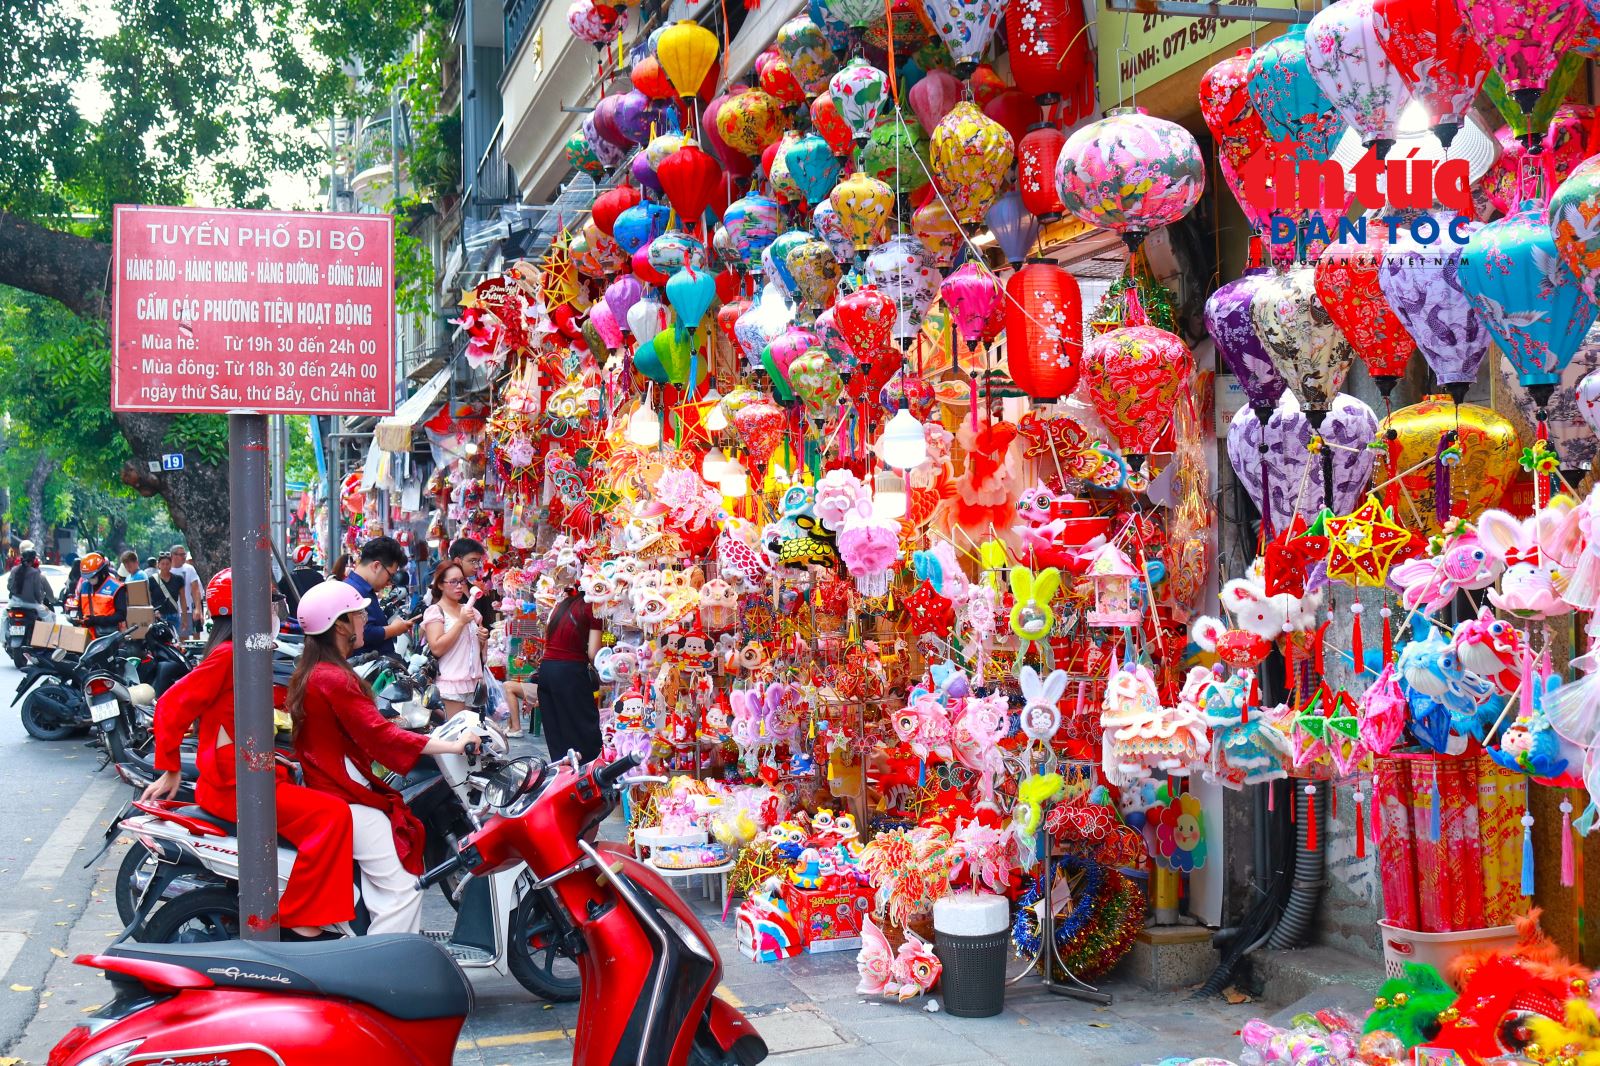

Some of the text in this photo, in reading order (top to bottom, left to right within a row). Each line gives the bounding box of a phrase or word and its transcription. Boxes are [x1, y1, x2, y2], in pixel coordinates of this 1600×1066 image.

[146, 219, 365, 257] TUYẾN PHỐ ĐI BỘ
[126, 253, 383, 287] HÀNG ĐÀO HÀNG NGANG HÀNG ĐƯỜNG ĐỒNG XUÂN
[137, 292, 372, 331] CẤM CÁC PHƯƠNG TIỆN HOẠT ĐỘNG
[141, 334, 172, 350] Mùa
[224, 335, 244, 351] Từ
[247, 336, 273, 352] 19h
[277, 337, 294, 352] 30
[298, 335, 325, 353] đến
[329, 338, 355, 354] 24h
[359, 340, 376, 355] 00
[142, 358, 377, 379] Mùa đông: Từ 18h 30 đến 24h 00
[141, 381, 376, 407] ngày thứ Sáu, thứ Bẩy, Chủ nhật
[166, 456, 180, 468] 19
[207, 966, 292, 985] Grande
